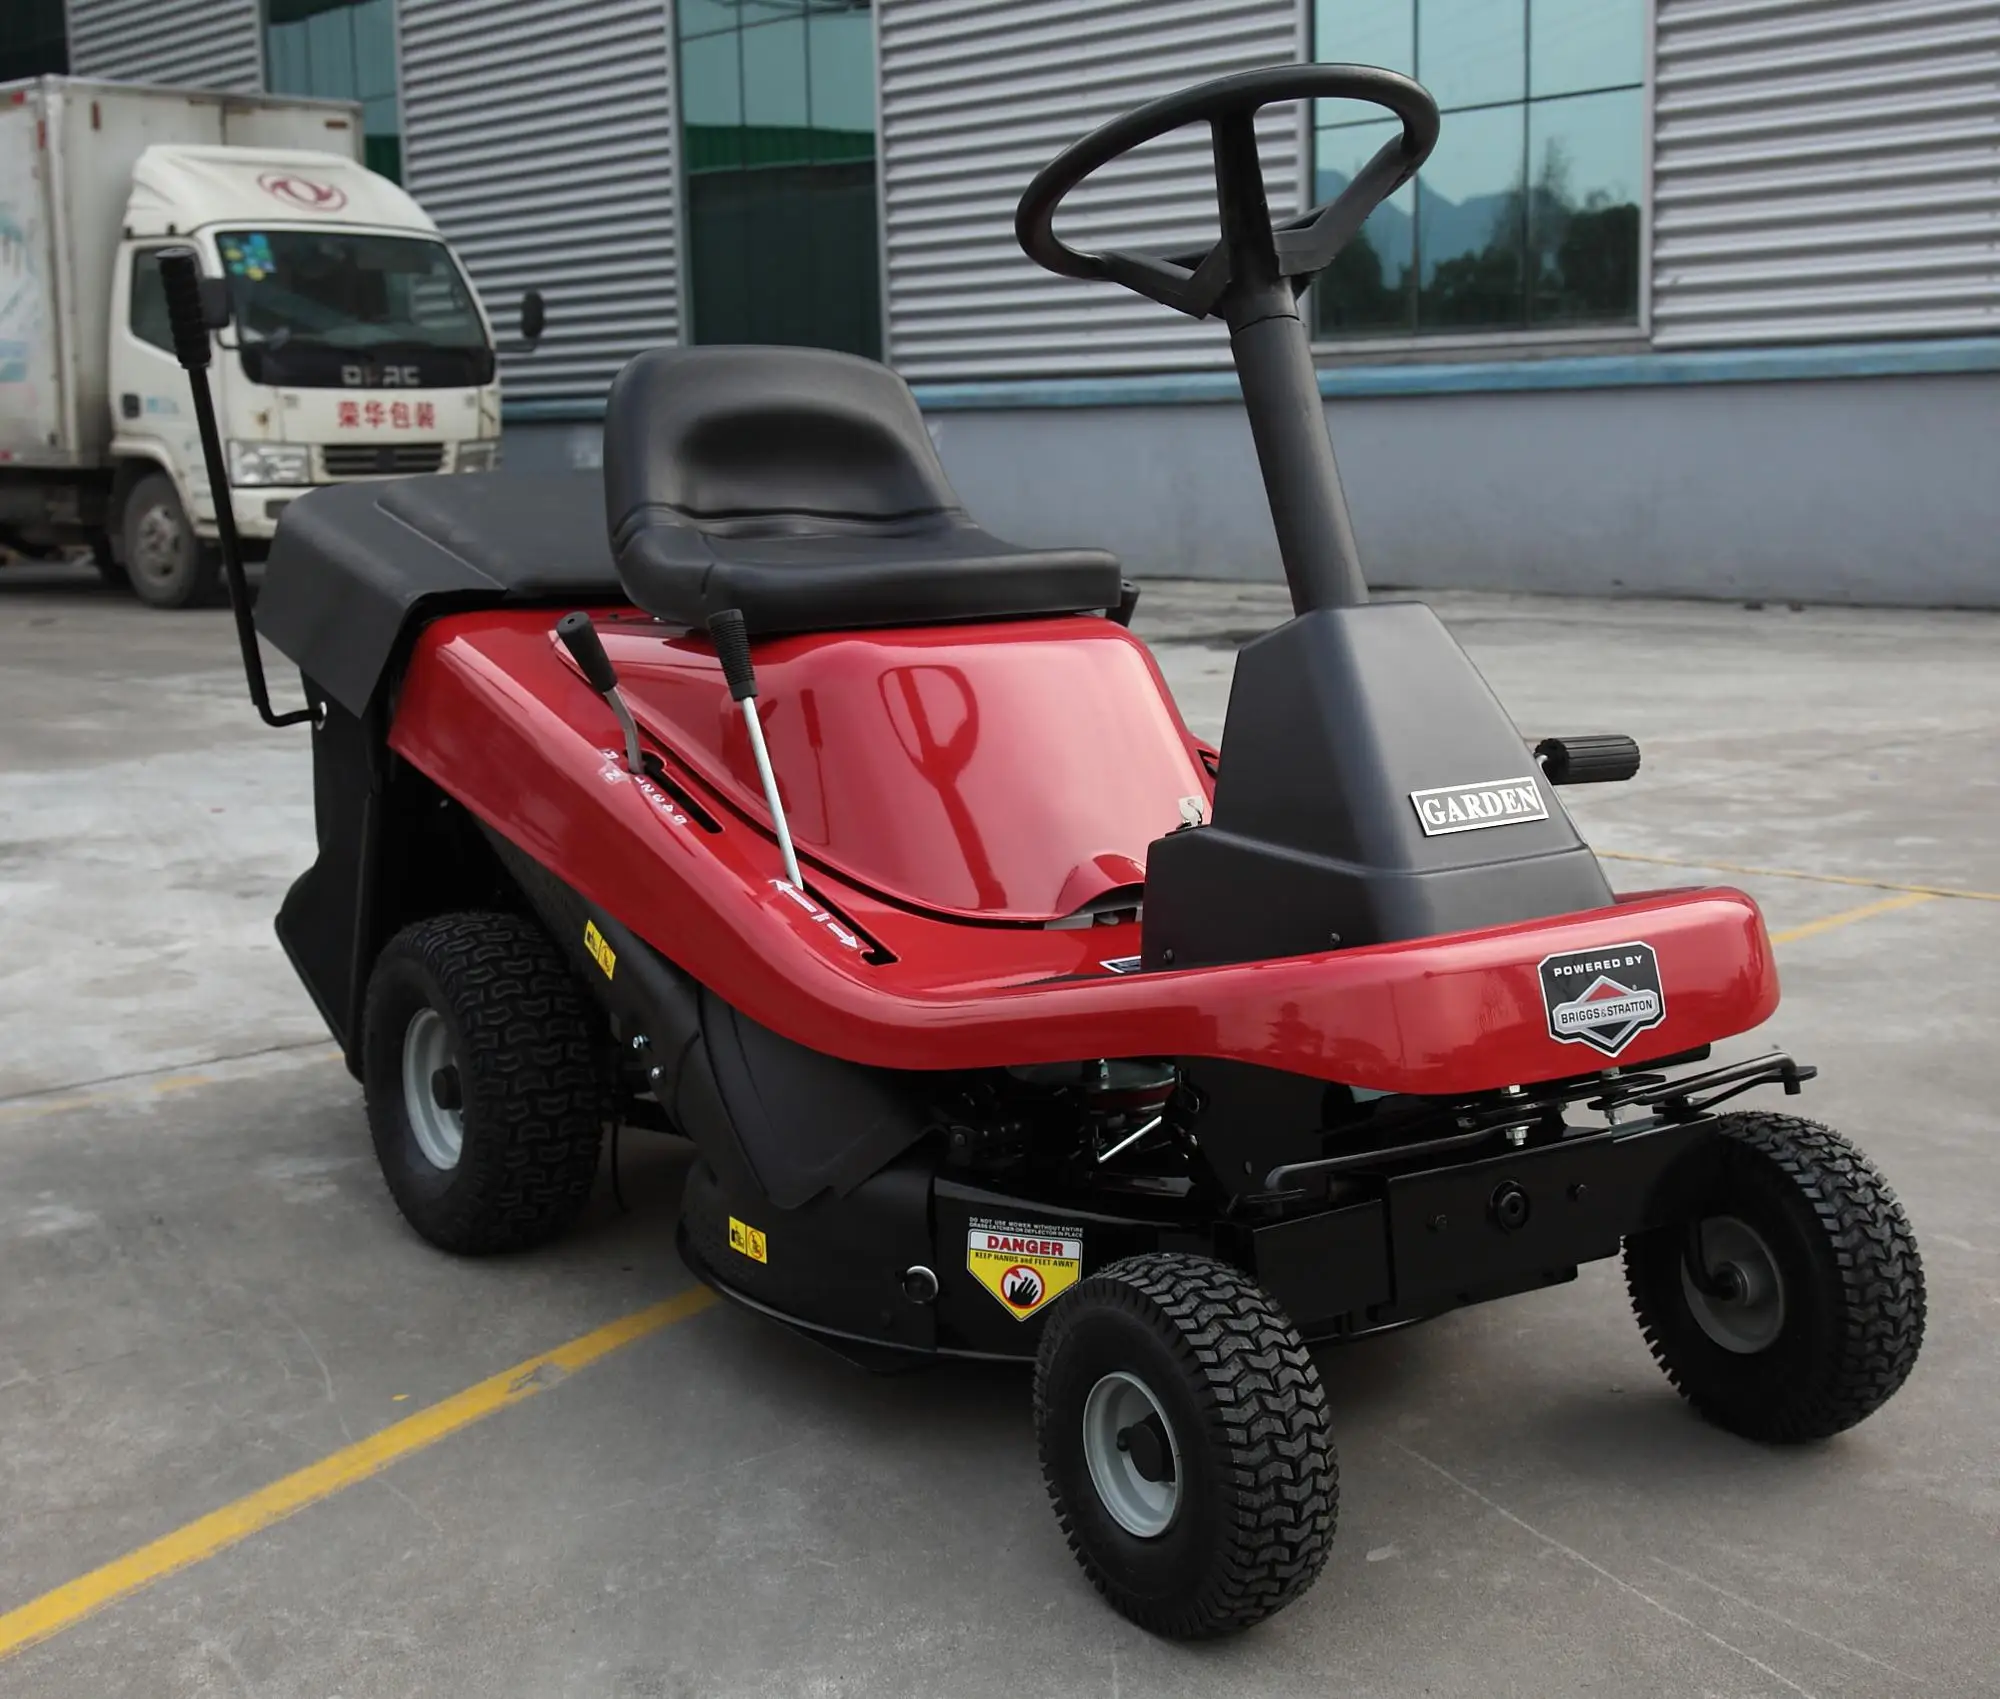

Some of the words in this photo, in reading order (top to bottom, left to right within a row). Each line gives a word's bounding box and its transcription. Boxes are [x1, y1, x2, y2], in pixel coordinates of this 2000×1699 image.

[337, 399, 436, 429] 荣华包装
[1422, 785, 1541, 825] GARDEN
[1553, 958, 1621, 977] POWERED
[1624, 954, 1643, 966] BY
[988, 1224, 1015, 1232] CATCHER
[1024, 1228, 1057, 1236] DEFLECTOR
[1033, 1223, 1061, 1231] WITHOUT
[987, 1235, 1064, 1256] DANGER
[975, 1252, 993, 1260] KEEP
[993, 1254, 1019, 1263] HANDS
[1020, 1256, 1032, 1264] and
[1034, 1257, 1051, 1266] FEET
[1053, 1259, 1074, 1268] AWAY
